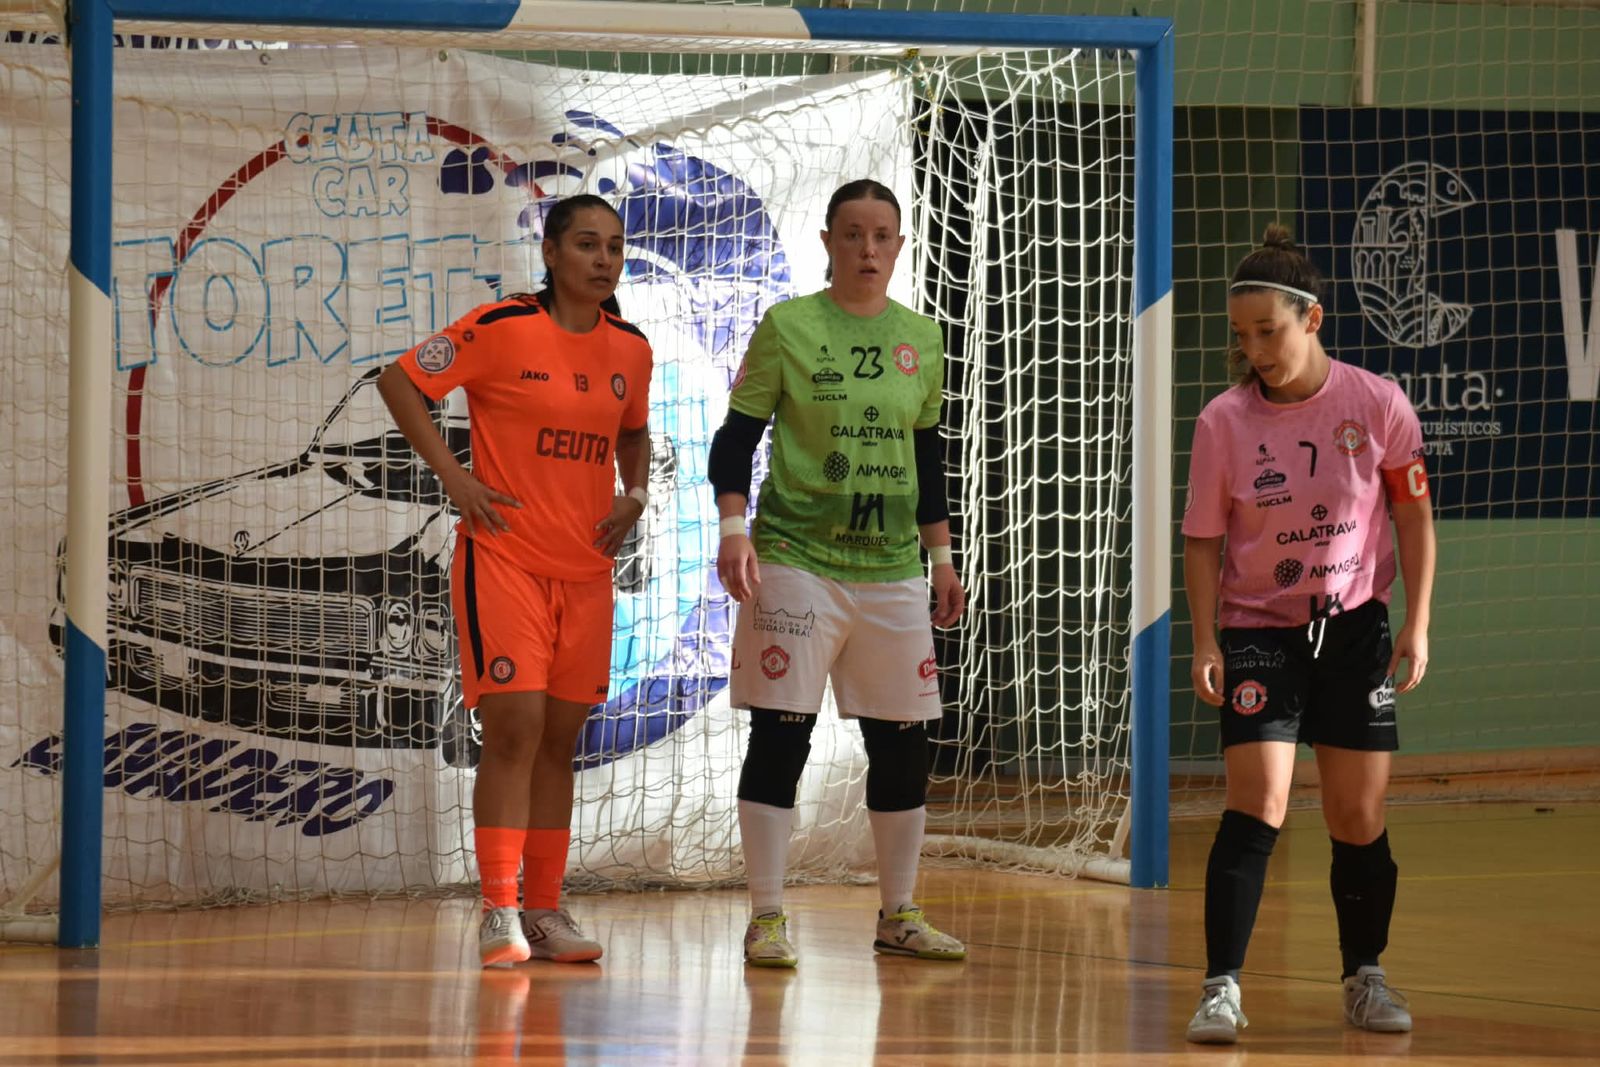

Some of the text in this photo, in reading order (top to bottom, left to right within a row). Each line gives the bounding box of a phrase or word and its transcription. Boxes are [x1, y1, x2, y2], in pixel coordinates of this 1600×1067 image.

[284, 111, 435, 164] CEUTA
[313, 165, 409, 217] CAR
[520, 370, 549, 381] JAKO
[851, 346, 884, 379] 23
[573, 372, 588, 392] 13
[536, 427, 609, 466] CEUTA
[830, 425, 904, 441] CALATRAVA
[1298, 441, 1317, 477] 7
[1408, 463, 1426, 496] C
[1276, 520, 1356, 545] CALATRAVA
